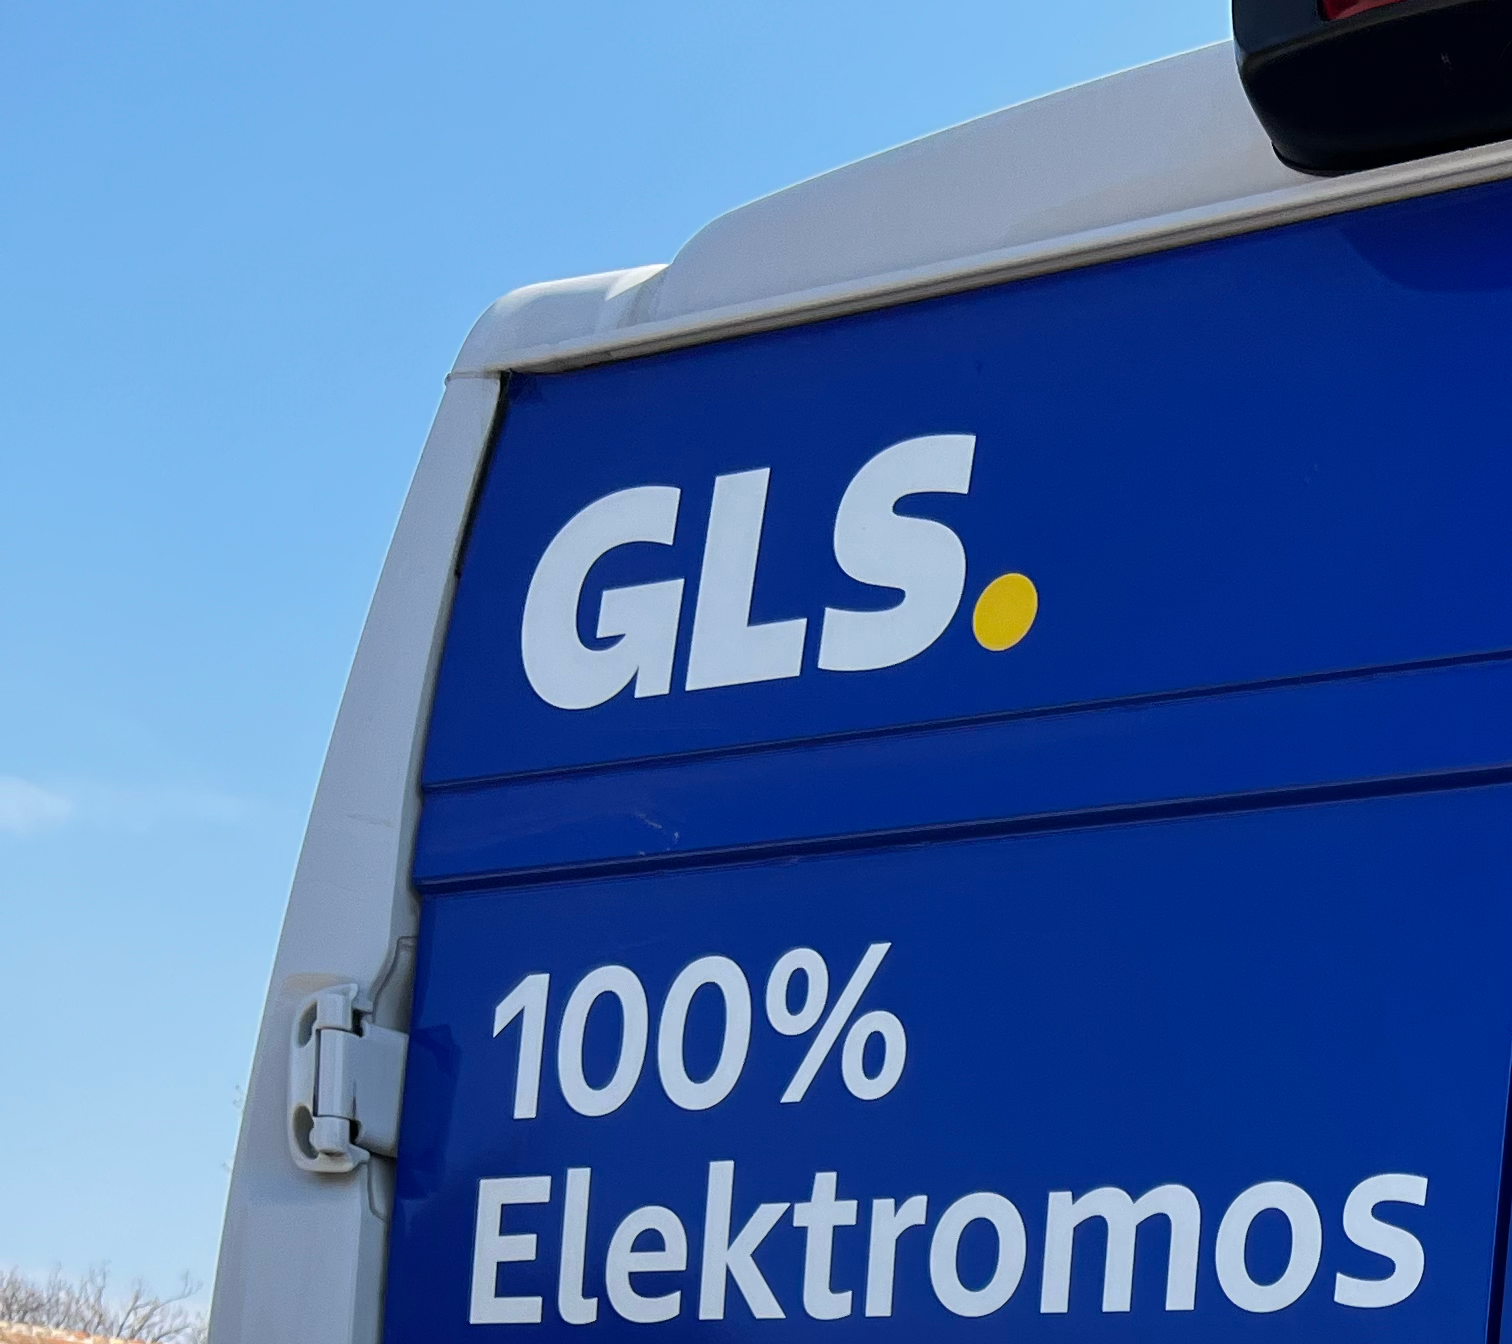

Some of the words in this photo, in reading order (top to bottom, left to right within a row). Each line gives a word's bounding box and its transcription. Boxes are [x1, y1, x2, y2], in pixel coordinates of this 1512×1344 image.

[521, 434, 1039, 710] GLS.
[492, 942, 907, 1119] 100%
[469, 1160, 1429, 1325] Elektromos
